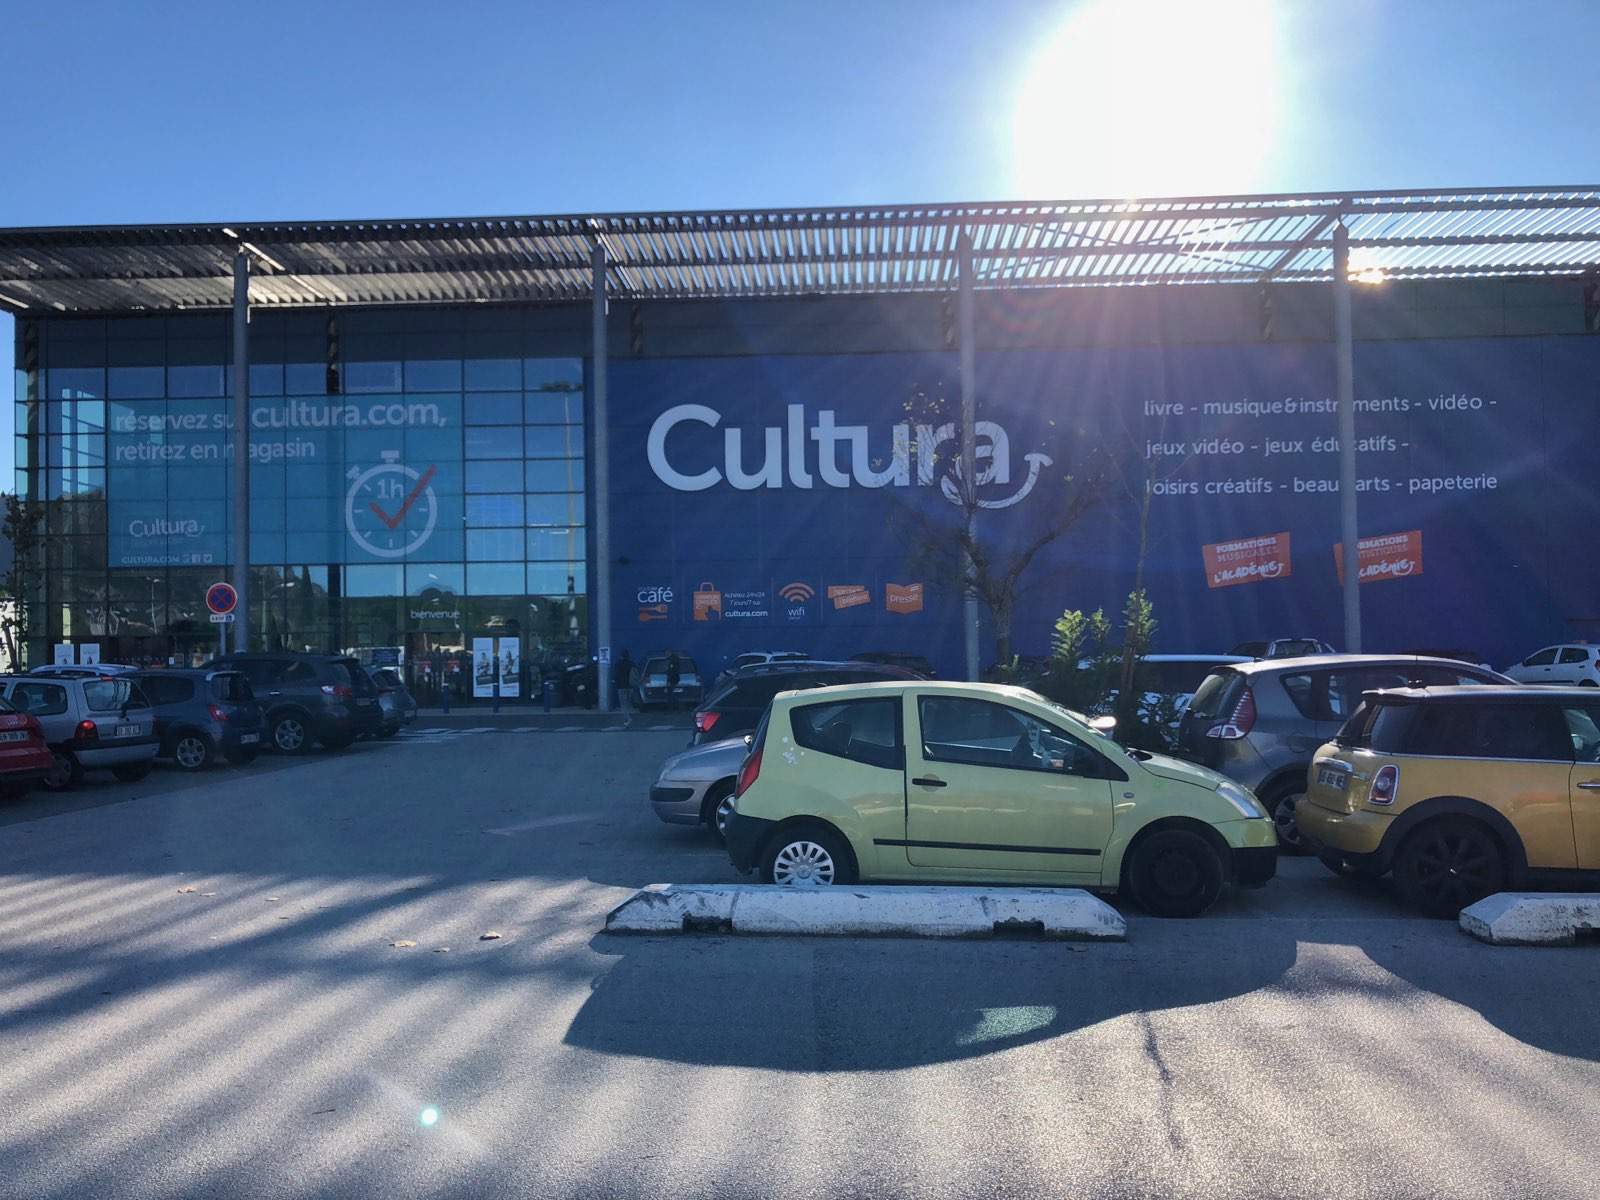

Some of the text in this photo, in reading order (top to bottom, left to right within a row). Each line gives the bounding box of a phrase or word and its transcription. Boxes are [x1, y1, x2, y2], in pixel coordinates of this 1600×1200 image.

[115, 410, 208, 431] réservez
[251, 400, 446, 428] cultura.com,
[1144, 399, 1184, 416] livre
[1428, 394, 1482, 411] vidéo
[115, 440, 186, 461] retirez
[190, 444, 218, 459] en
[647, 403, 1013, 491] Cultura
[1146, 439, 1185, 459] jeux
[1192, 438, 1244, 454] vidéo
[1264, 438, 1303, 456] jeux
[377, 478, 404, 499] 1h
[1146, 478, 1199, 494] loisirs
[1205, 477, 1273, 494] créatifs
[1293, 477, 1341, 493] beau
[1355, 477, 1390, 492] arts
[1408, 473, 1498, 495] papeterie
[129, 518, 204, 538] Cultura
[1216, 537, 1277, 553] FORMATIONS
[637, 586, 673, 603] café
[410, 609, 461, 619] bienvenue
